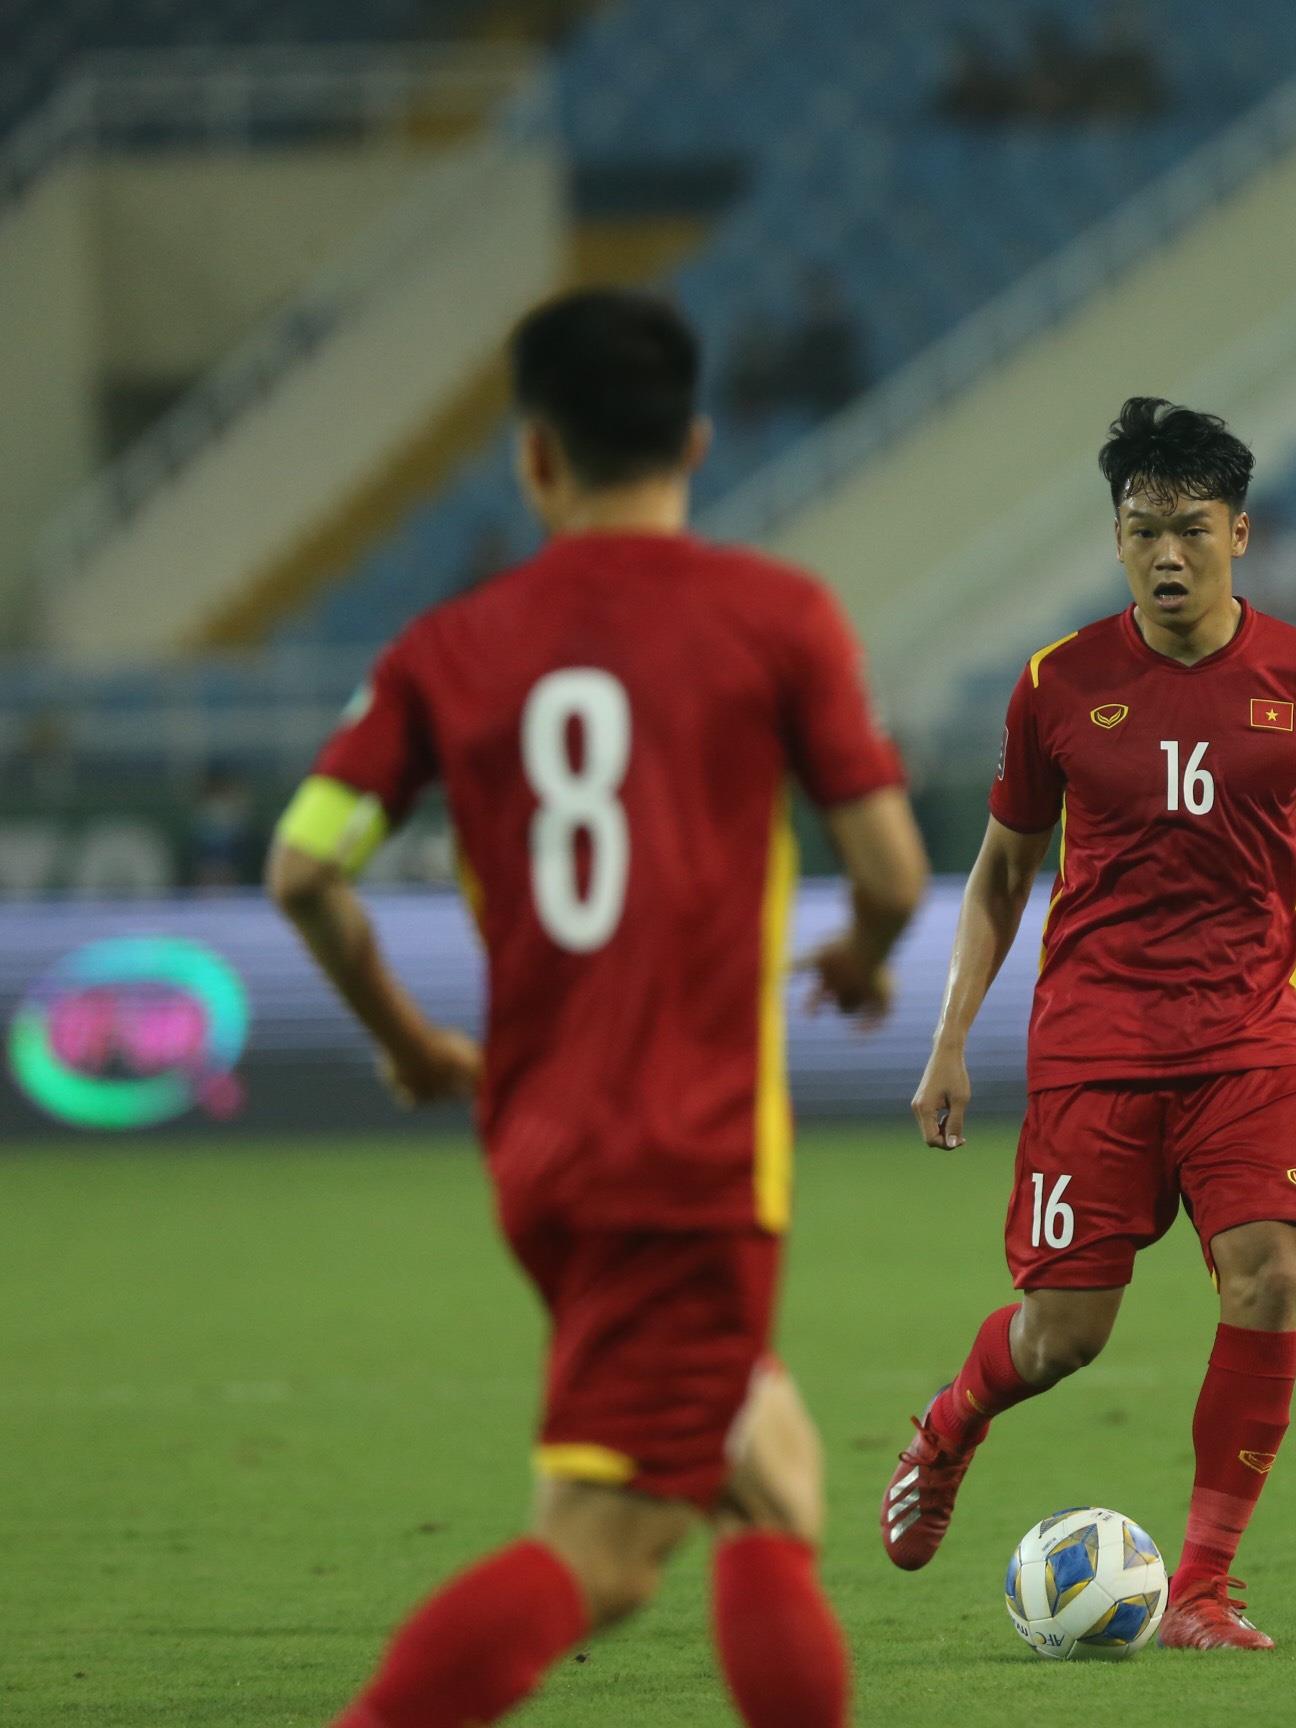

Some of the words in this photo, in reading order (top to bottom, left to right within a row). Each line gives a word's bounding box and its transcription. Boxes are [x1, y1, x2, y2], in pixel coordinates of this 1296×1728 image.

[521, 667, 632, 953] 8
[1160, 740, 1215, 816] 16
[1031, 1172, 1074, 1249] 16
